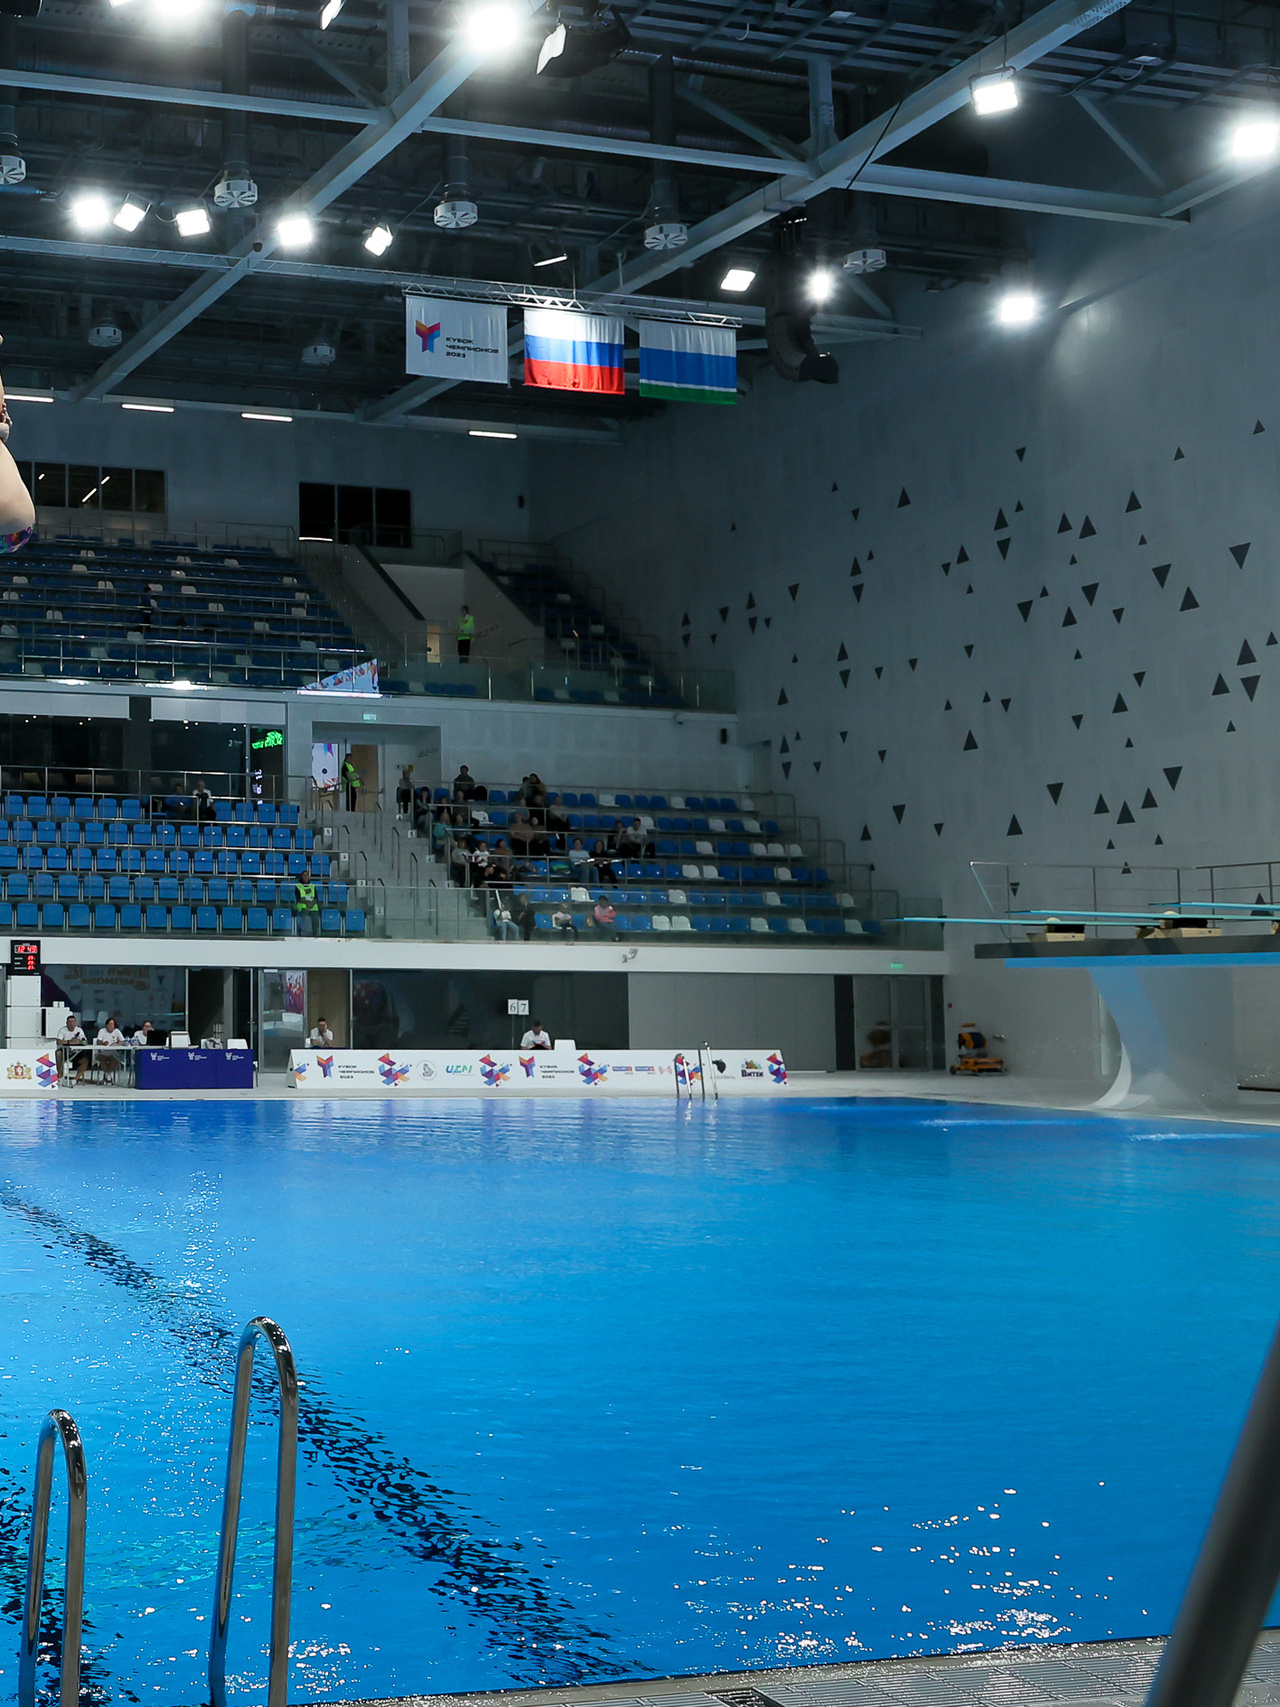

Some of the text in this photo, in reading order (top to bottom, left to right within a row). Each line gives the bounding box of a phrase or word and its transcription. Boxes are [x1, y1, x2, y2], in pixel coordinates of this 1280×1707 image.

[445, 336, 474, 345] КУБОК
[445, 344, 499, 354] ЧЕМПИОНОВ
[510, 1003, 516, 1012] 6
[520, 1003, 526, 1012] 7
